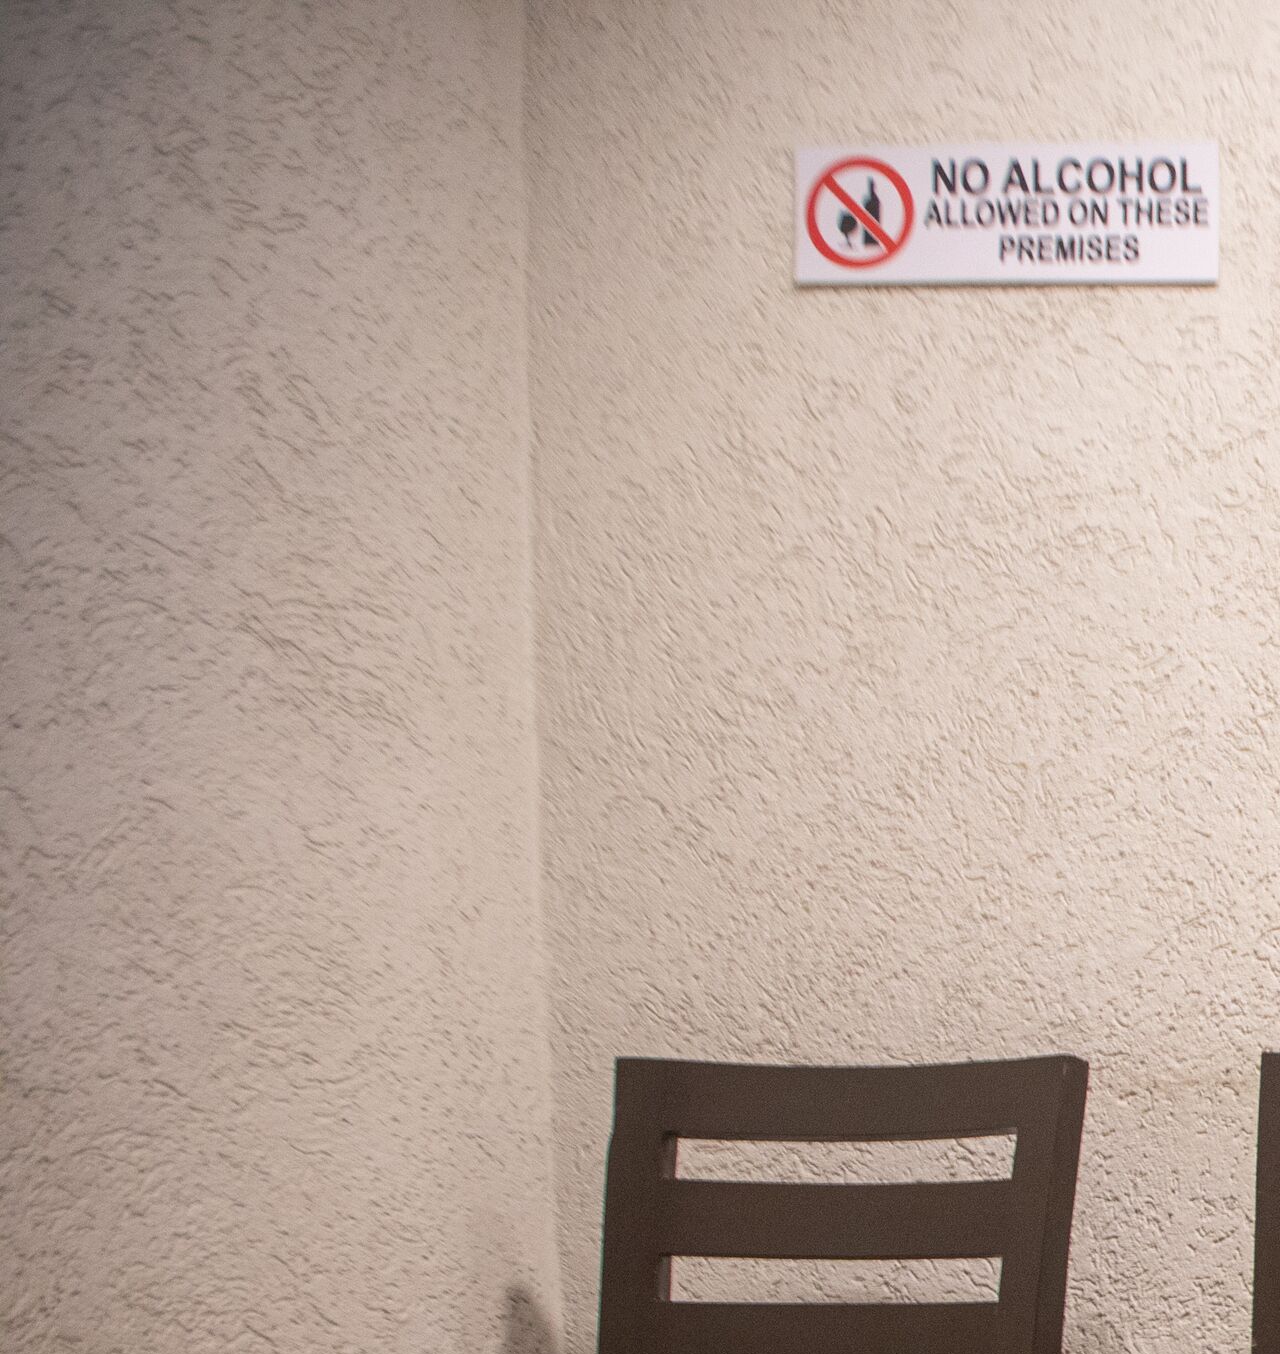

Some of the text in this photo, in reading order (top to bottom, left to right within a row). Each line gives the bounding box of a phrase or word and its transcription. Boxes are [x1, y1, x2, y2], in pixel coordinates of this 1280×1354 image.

[931, 157, 1203, 196] NO ALCOHOL
[923, 198, 1210, 230] ALLOWED ON THESE
[999, 233, 1140, 264] PREMISES
